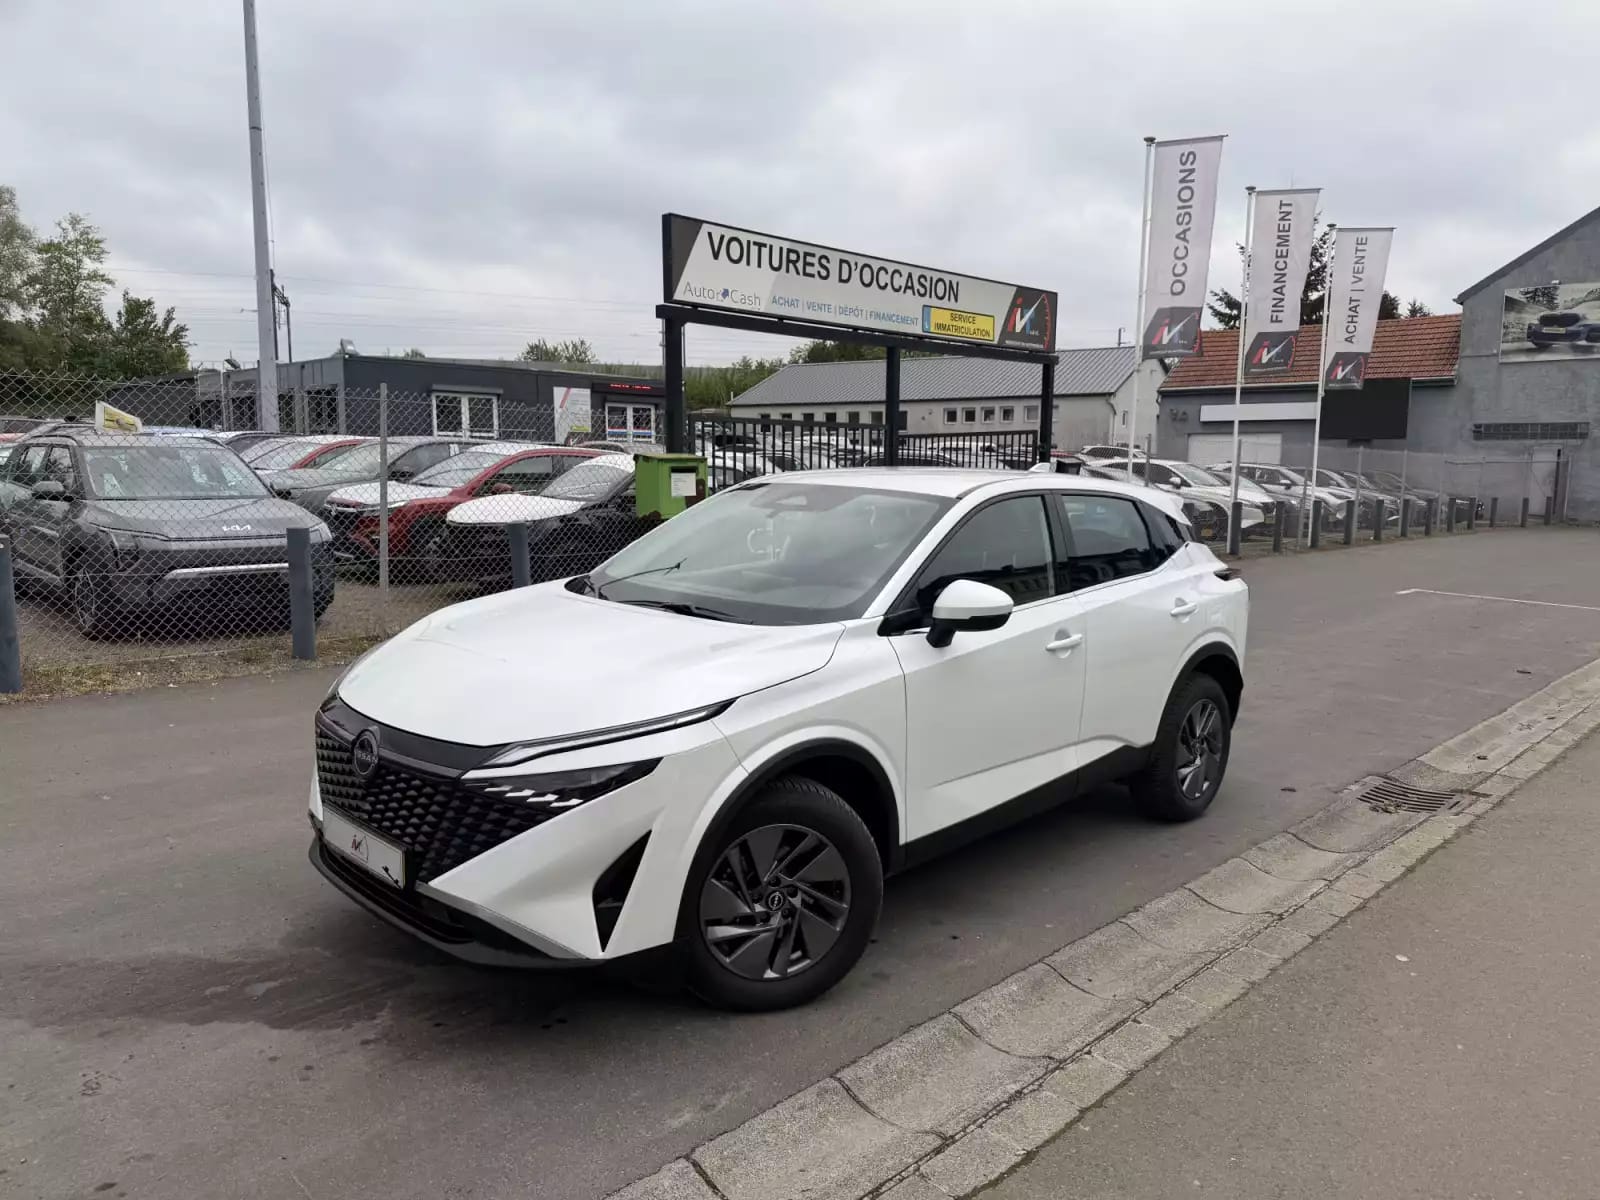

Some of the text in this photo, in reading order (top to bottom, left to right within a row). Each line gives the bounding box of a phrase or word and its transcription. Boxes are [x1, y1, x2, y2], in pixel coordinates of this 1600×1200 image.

[1170, 150, 1197, 297] OCCASIONS
[707, 231, 830, 281] VOITURES
[1270, 199, 1293, 324] FINANCEMENT
[772, 295, 800, 309] ACHAT
[806, 301, 832, 314] VENTE
[869, 310, 919, 327] FINANCEMENT
[1344, 236, 1368, 344] ACHAT VENTE
[934, 322, 991, 338] IMMATRICULATION
[949, 312, 976, 325] SERVICE
